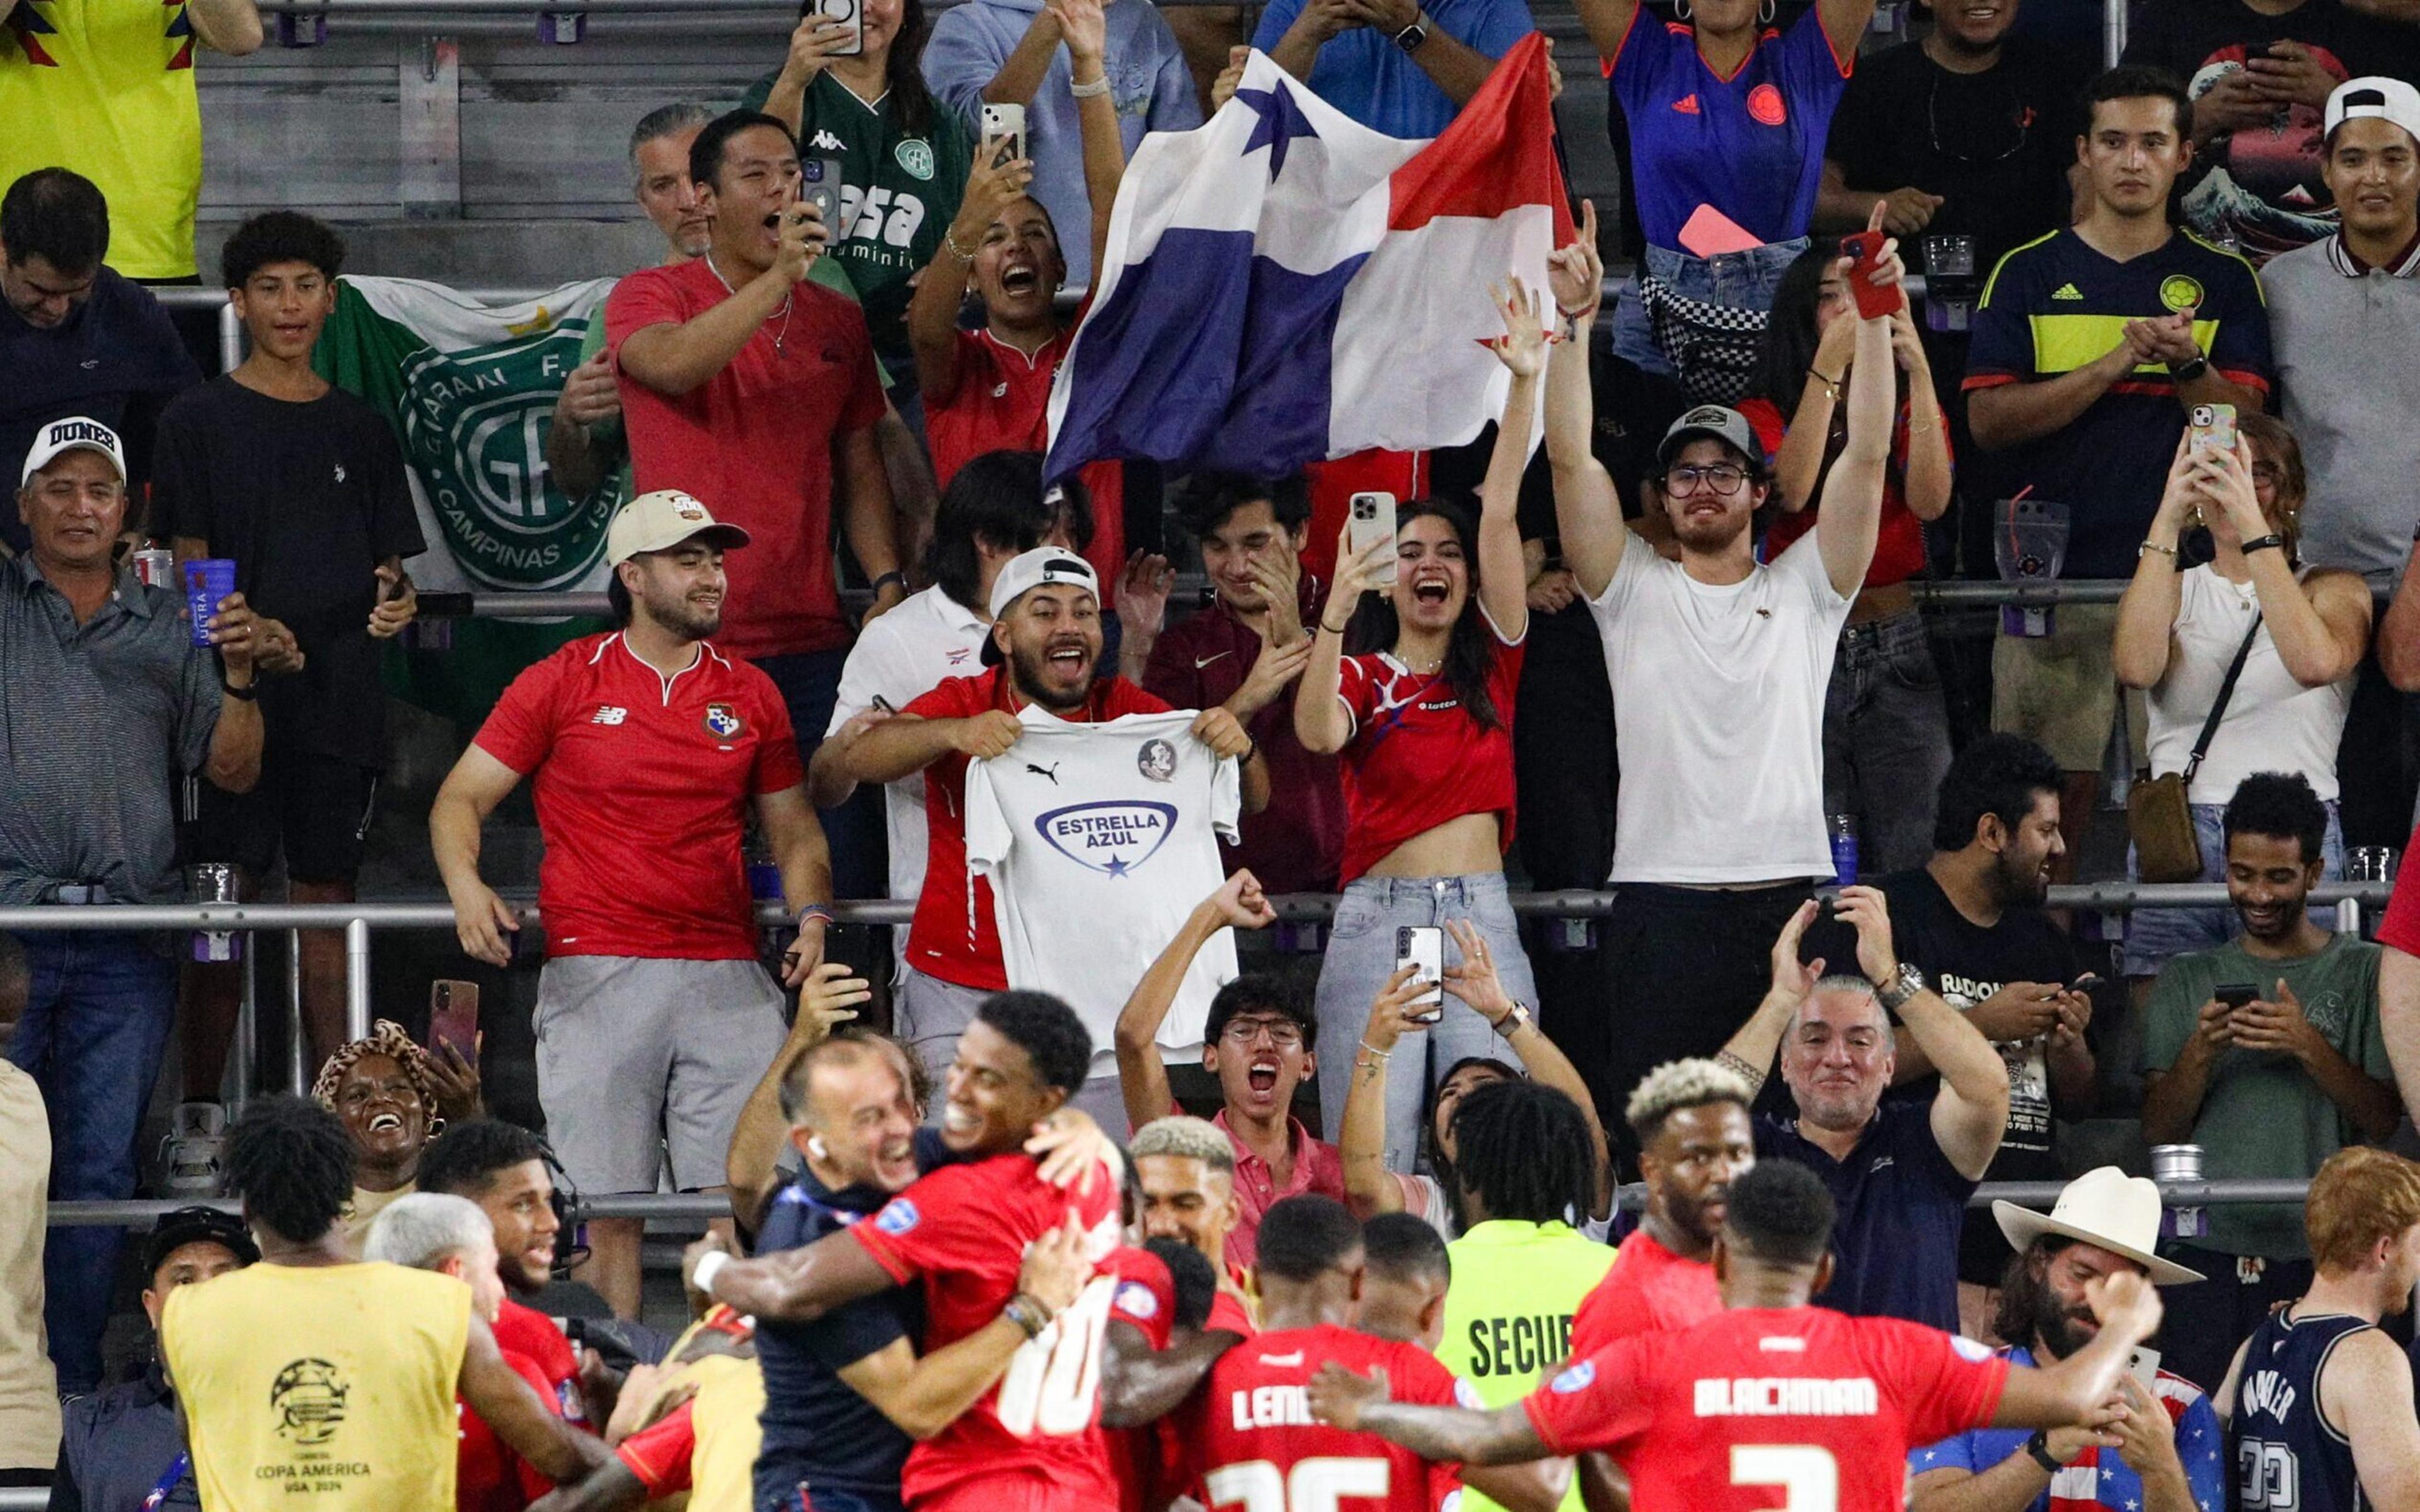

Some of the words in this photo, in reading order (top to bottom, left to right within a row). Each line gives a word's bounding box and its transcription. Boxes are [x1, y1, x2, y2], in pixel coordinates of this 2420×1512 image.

[50, 421, 115, 452] DUNES
[439, 489, 560, 569] CAMPINAS
[197, 593, 209, 639] ULTRA
[1427, 700, 1457, 710] lotto
[1056, 814, 1160, 836] ESTRELLA
[1086, 831, 1138, 849] AZUL
[255, 1465, 297, 1479] COPA
[285, 1482, 309, 1492] USA
